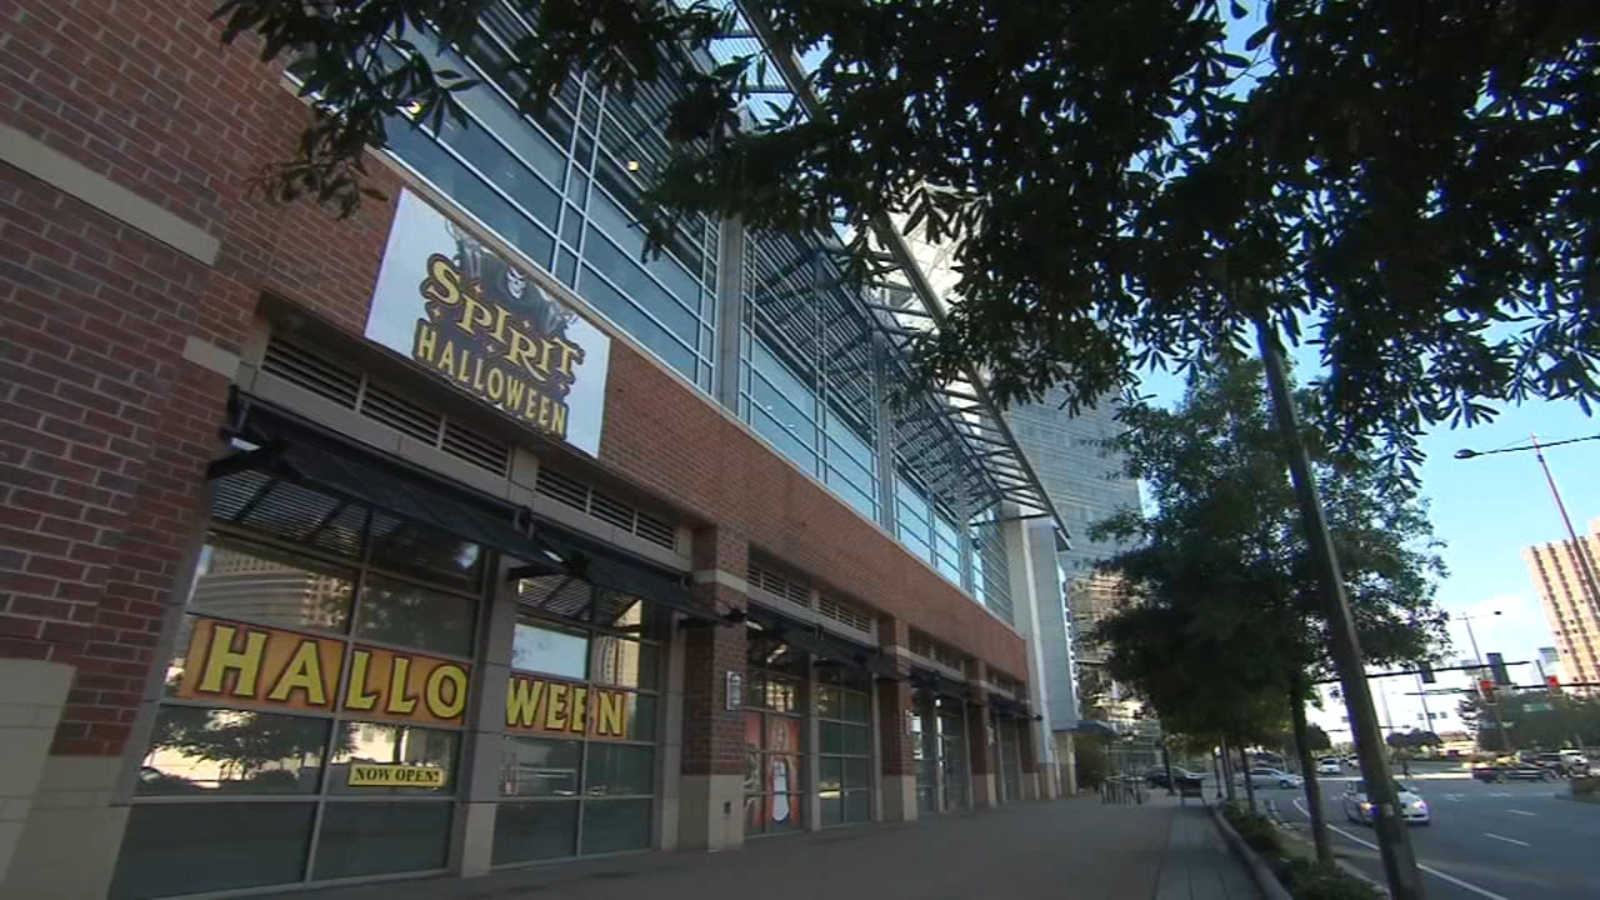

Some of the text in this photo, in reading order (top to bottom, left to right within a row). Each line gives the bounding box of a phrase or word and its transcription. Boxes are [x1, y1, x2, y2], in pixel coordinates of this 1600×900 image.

[425, 258, 582, 383] SPIRIT
[417, 325, 567, 435] HALLOWEEN
[198, 624, 625, 736] HALLO WEEN
[354, 767, 440, 783] NOW OPEN!
